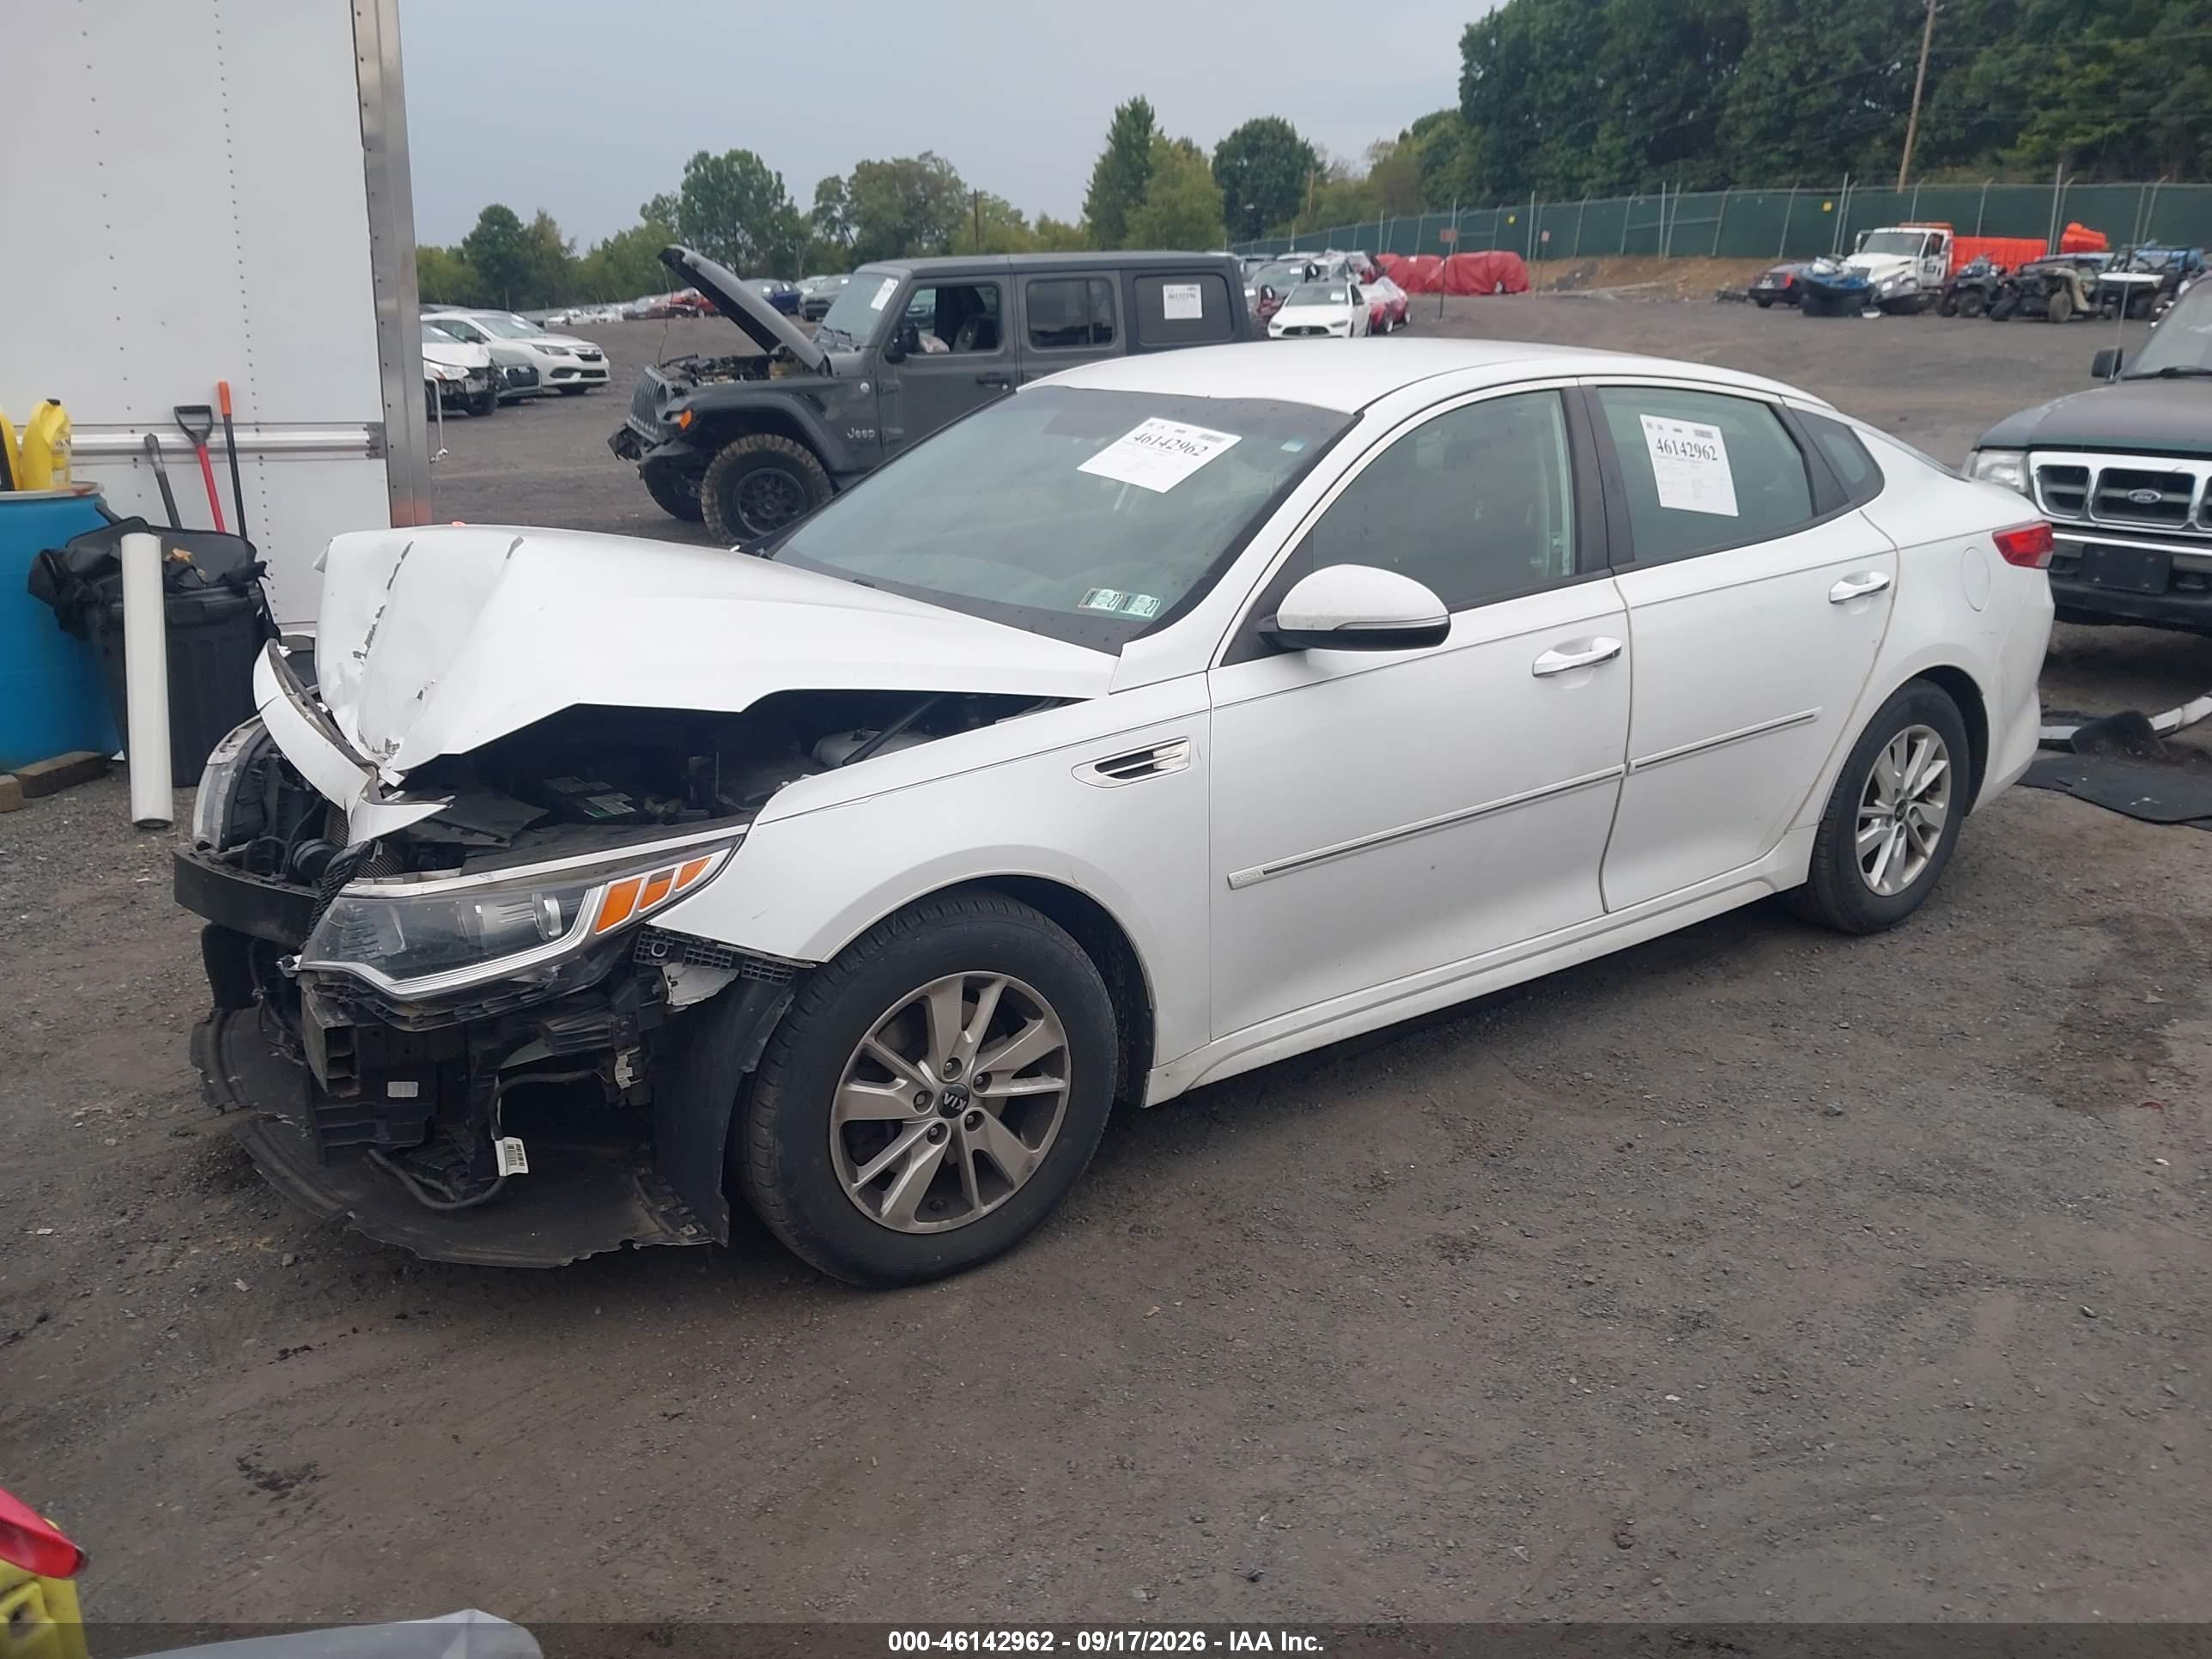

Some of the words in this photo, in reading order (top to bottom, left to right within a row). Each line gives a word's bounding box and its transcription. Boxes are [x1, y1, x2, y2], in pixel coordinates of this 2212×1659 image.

[847, 427, 876, 440] Jeep
[1133, 433, 1209, 457] 46142962
[1656, 437, 1718, 461] 46142962
[943, 1091, 967, 1111] KIA
